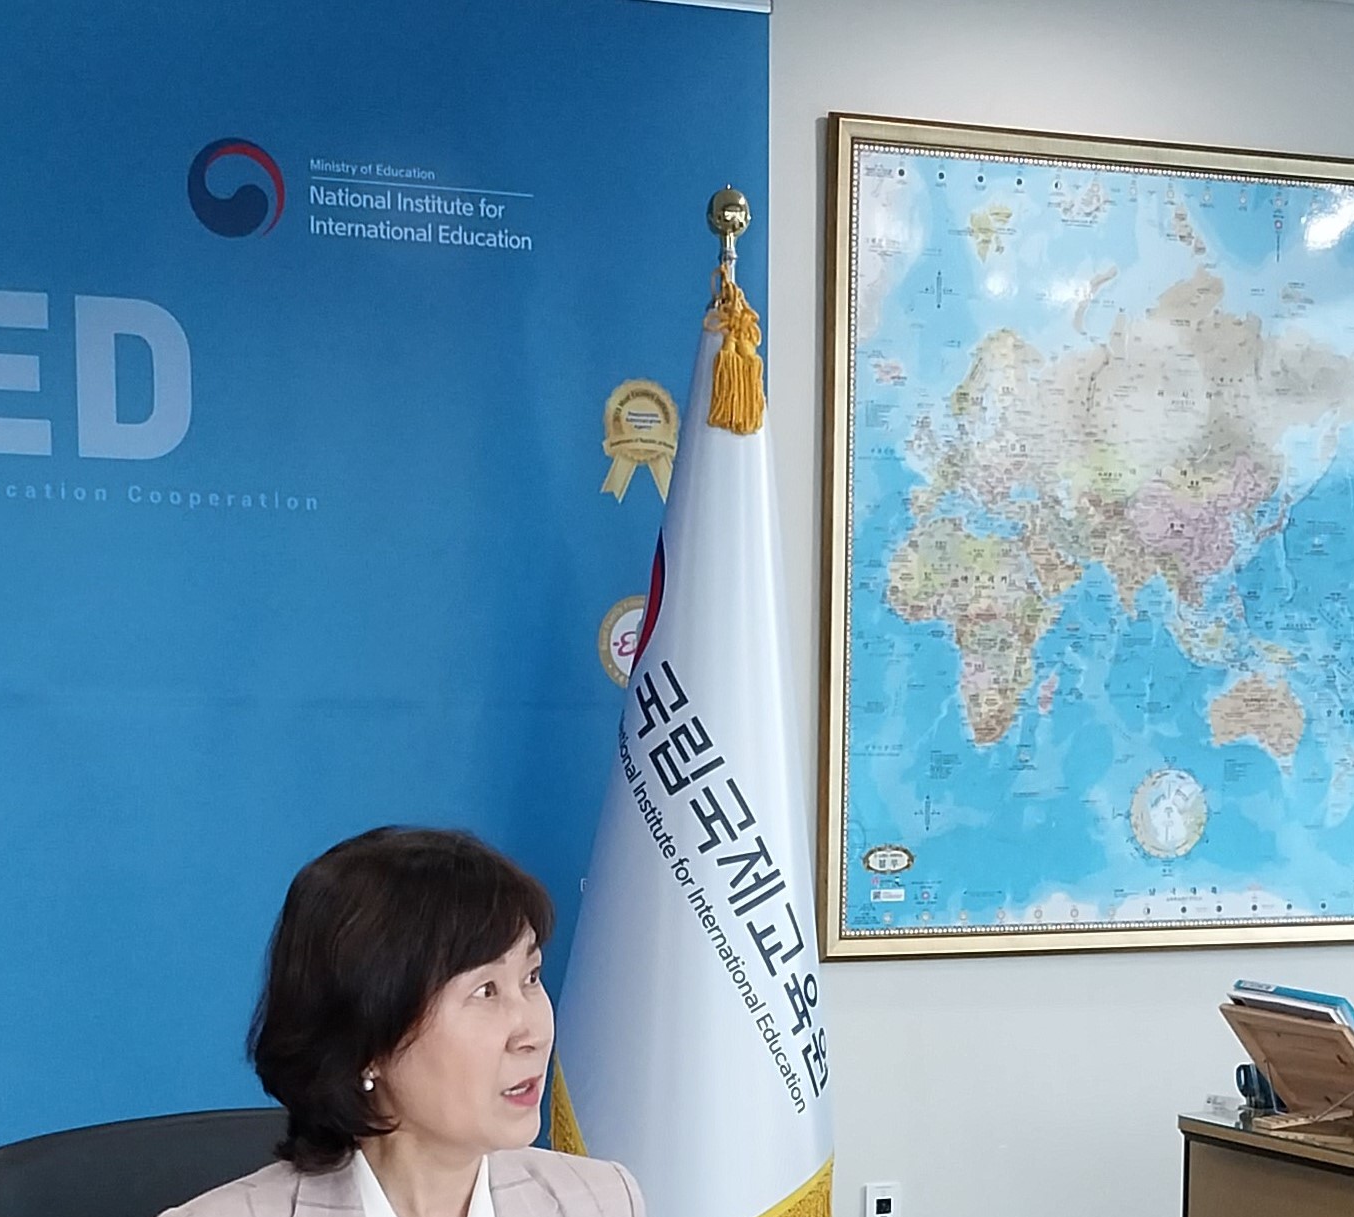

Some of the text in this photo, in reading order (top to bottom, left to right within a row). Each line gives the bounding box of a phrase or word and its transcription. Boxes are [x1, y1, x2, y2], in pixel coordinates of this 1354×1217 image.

[309, 158, 436, 181] Ministry of Education
[309, 185, 506, 220] National Institute for
[309, 215, 533, 251] International Education
[127, 485, 320, 512] Cooperation
[635, 660, 829, 1099] 국립국제교육원
[632, 780, 677, 860] Institute
[670, 857, 696, 887] for
[687, 886, 767, 1015] International
[755, 1012, 807, 1115] Education
